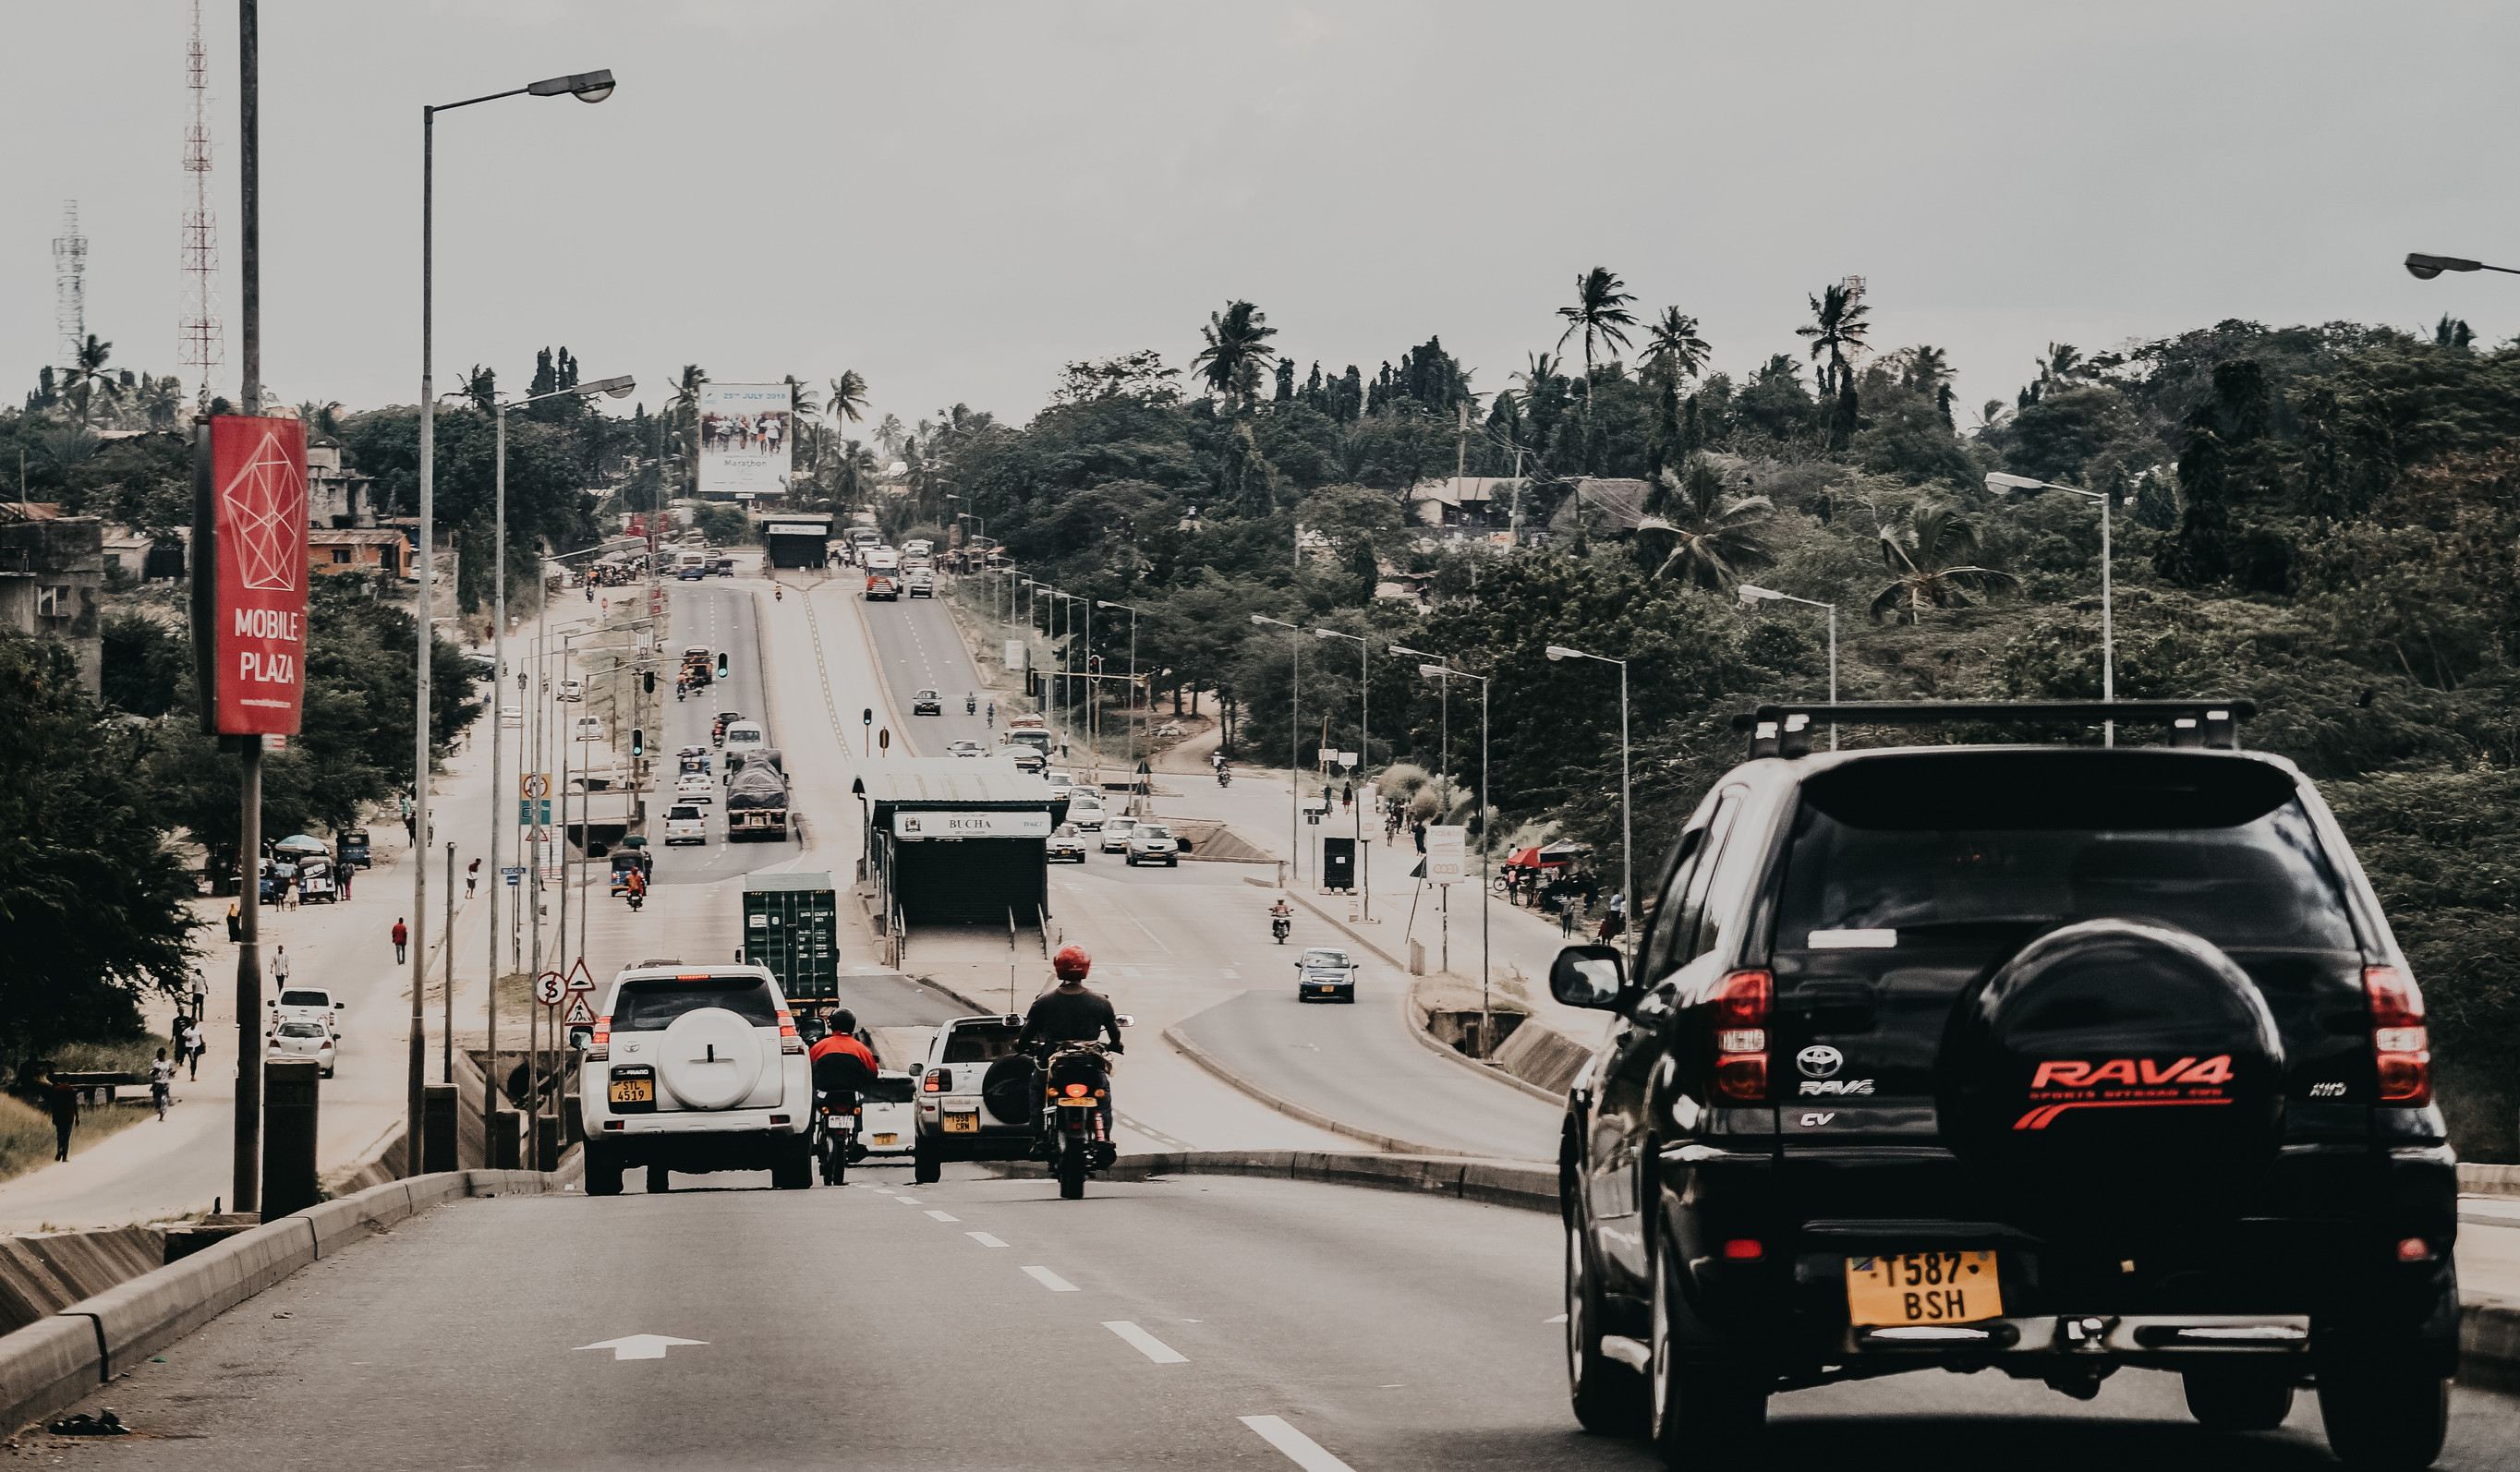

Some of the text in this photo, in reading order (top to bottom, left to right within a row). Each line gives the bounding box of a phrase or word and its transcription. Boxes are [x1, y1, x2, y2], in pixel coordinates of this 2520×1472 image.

[724, 459, 768, 467] Marathon
[235, 608, 298, 641] MOBILE
[240, 651, 295, 684] PLAZA
[949, 819, 992, 829] BUCHA
[2030, 1055, 2235, 1089] RAV4
[623, 1080, 640, 1091] STL
[1799, 1079, 1876, 1096] RAV4
[617, 1090, 645, 1102] 4519
[1800, 1112, 1835, 1127] CV
[1881, 1251, 1962, 1287] T587
[1904, 1289, 1966, 1321] BSH
